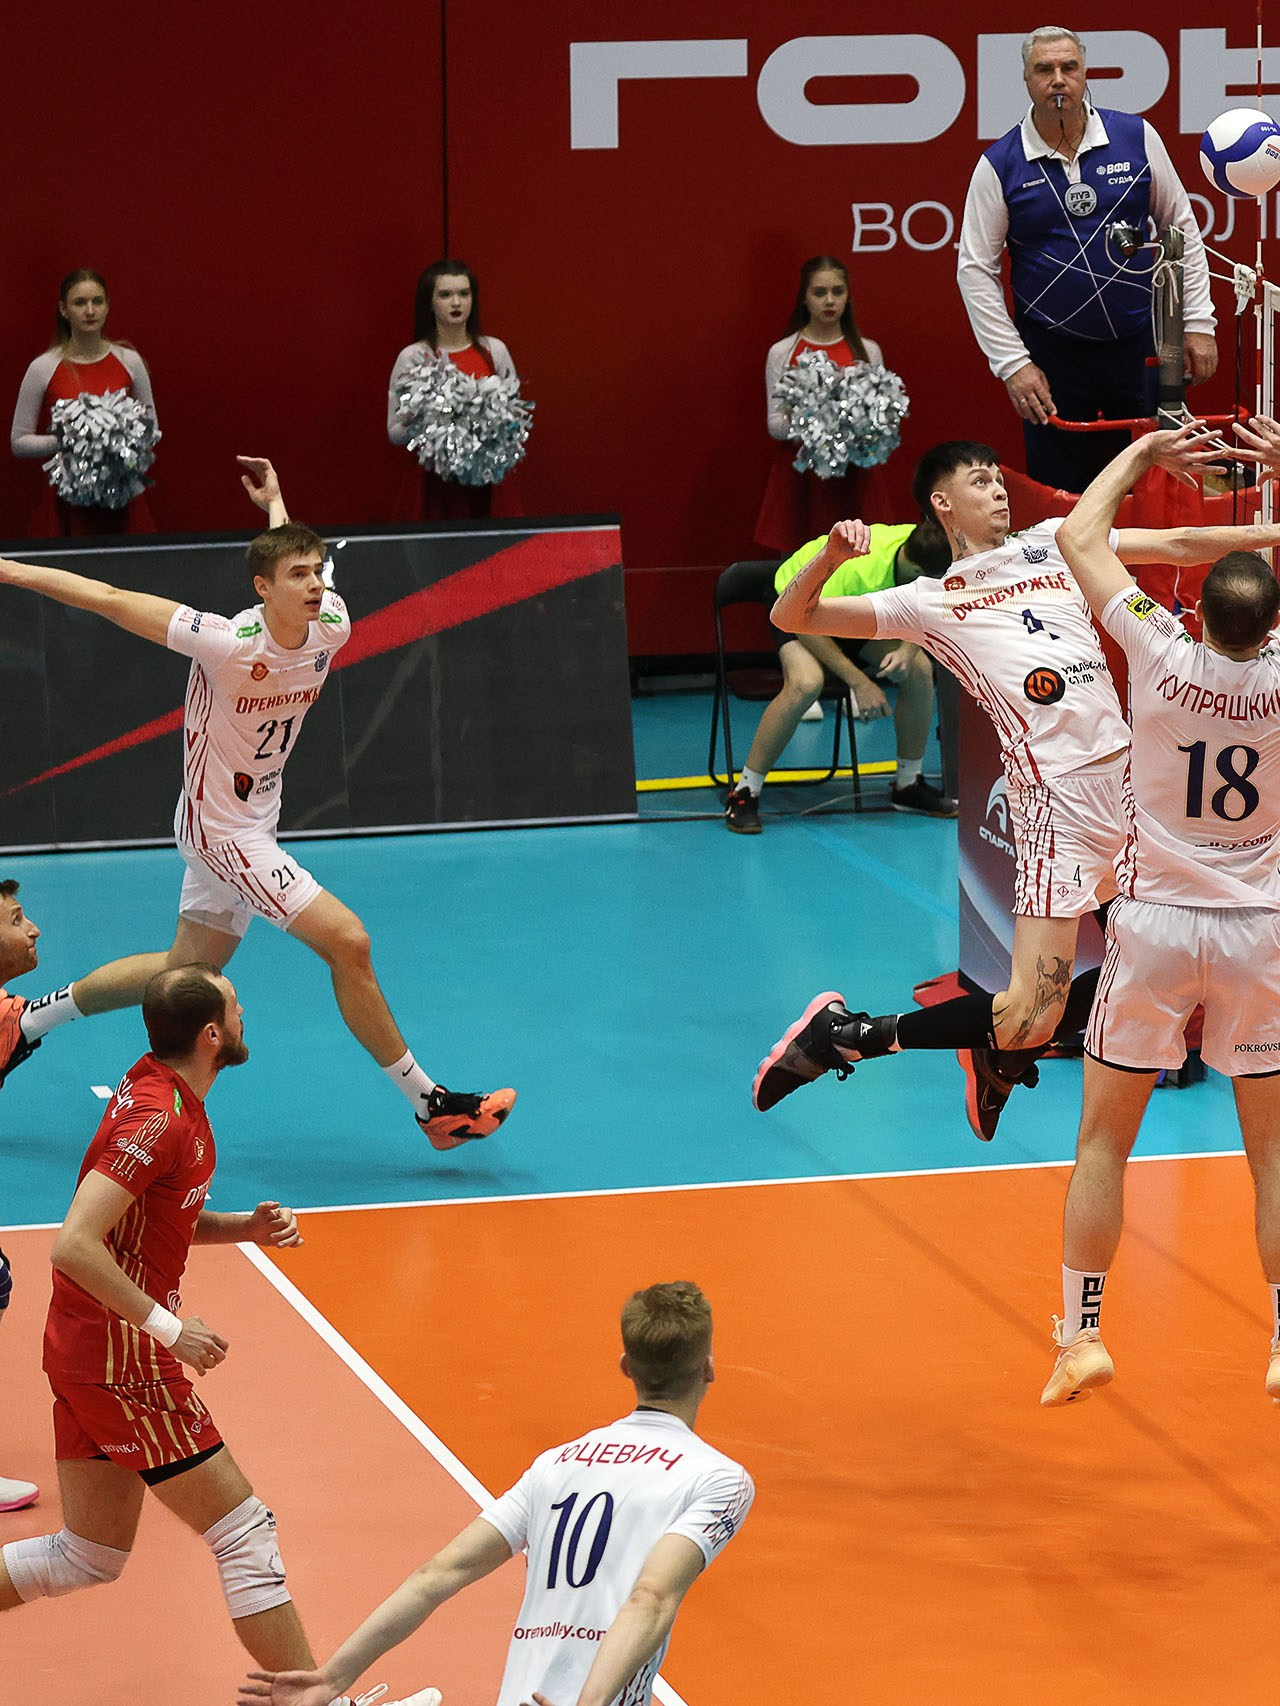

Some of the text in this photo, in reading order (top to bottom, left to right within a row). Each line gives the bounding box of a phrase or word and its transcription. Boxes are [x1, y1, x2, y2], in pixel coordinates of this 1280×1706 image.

[1106, 161, 1131, 175] ВФВ
[1108, 175, 1134, 186] СУДЬЯ
[254, 715, 297, 760] 21
[1177, 740, 1260, 821] 18
[271, 864, 296, 890] 21
[1073, 864, 1082, 887] 4
[125, 1142, 154, 1167] ВФВ
[555, 1442, 683, 1471] ЮЦЕВИЧ
[546, 1491, 614, 1590] 10
